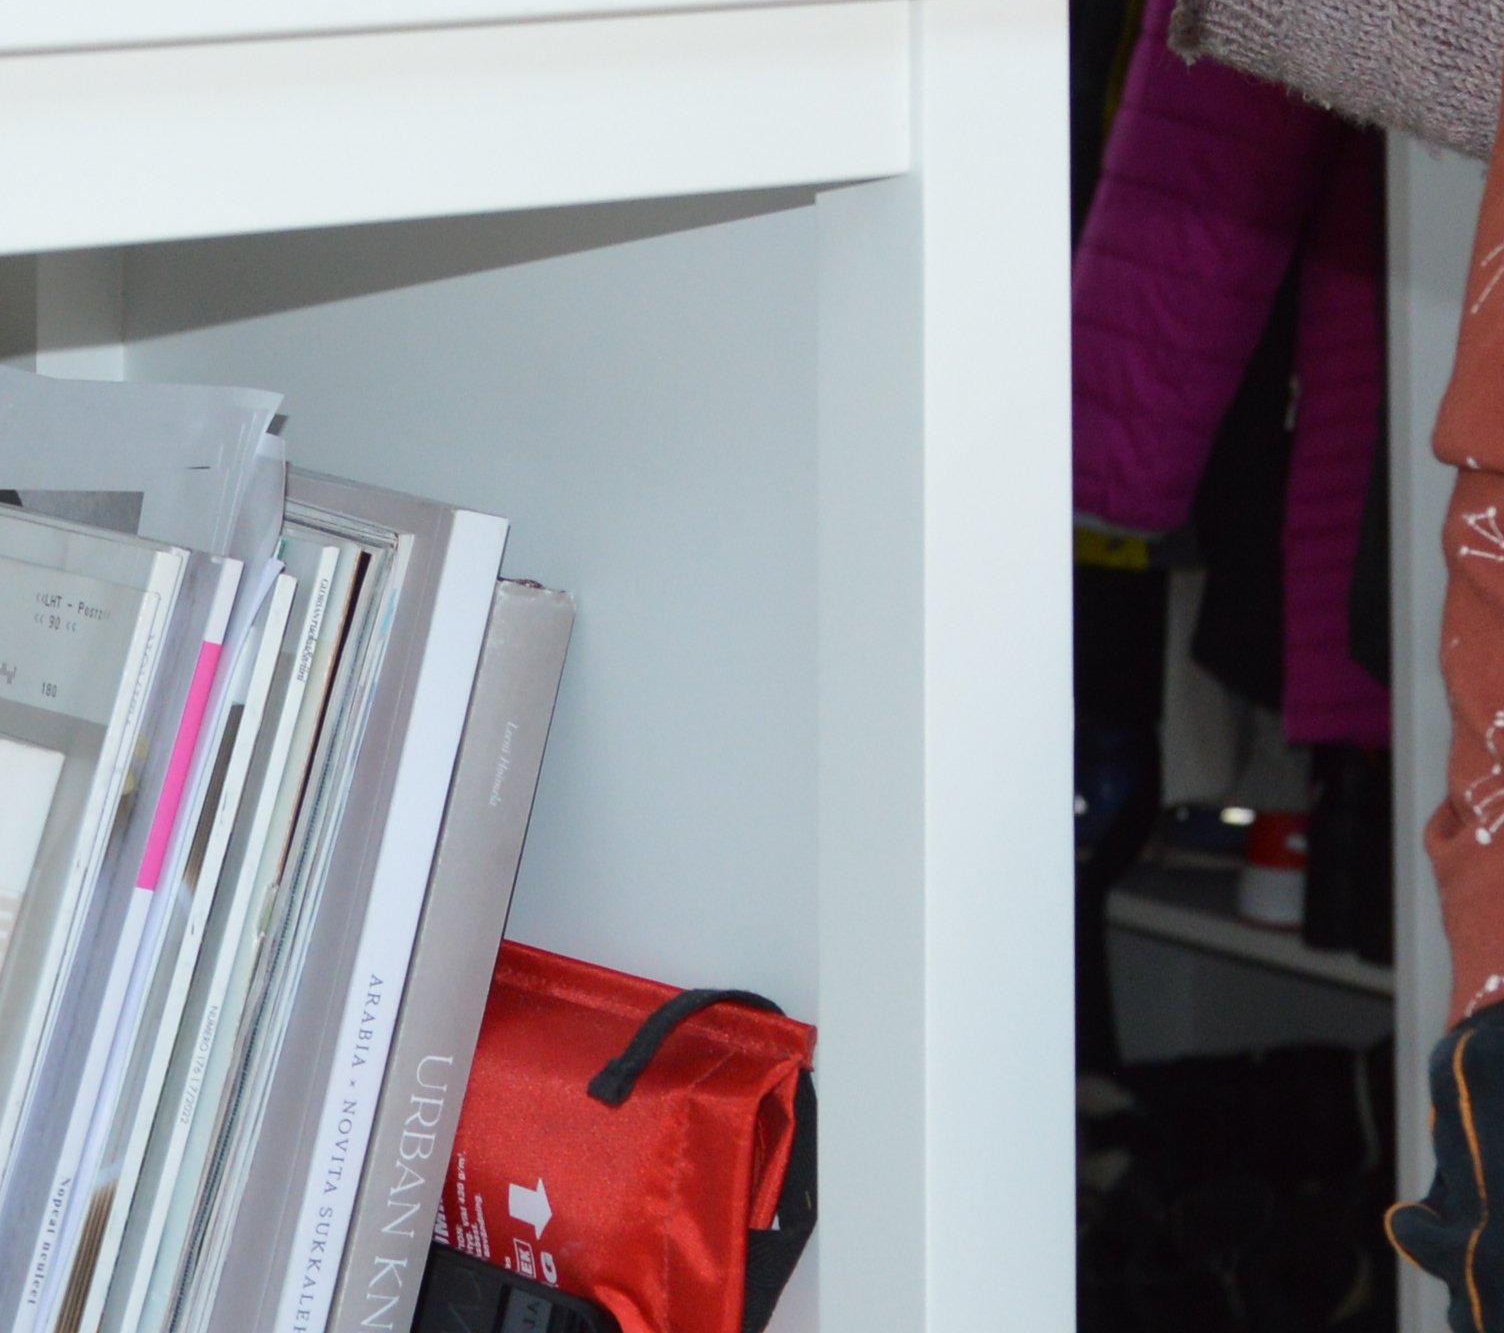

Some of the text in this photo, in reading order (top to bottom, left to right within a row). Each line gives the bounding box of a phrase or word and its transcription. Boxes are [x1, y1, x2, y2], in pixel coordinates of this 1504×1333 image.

[353, 973, 384, 1068] ARABIA
[322, 1099, 357, 1195] NOVITA
[358, 1055, 453, 1333] URBAN KN
[44, 1174, 71, 1235] Nopeat
